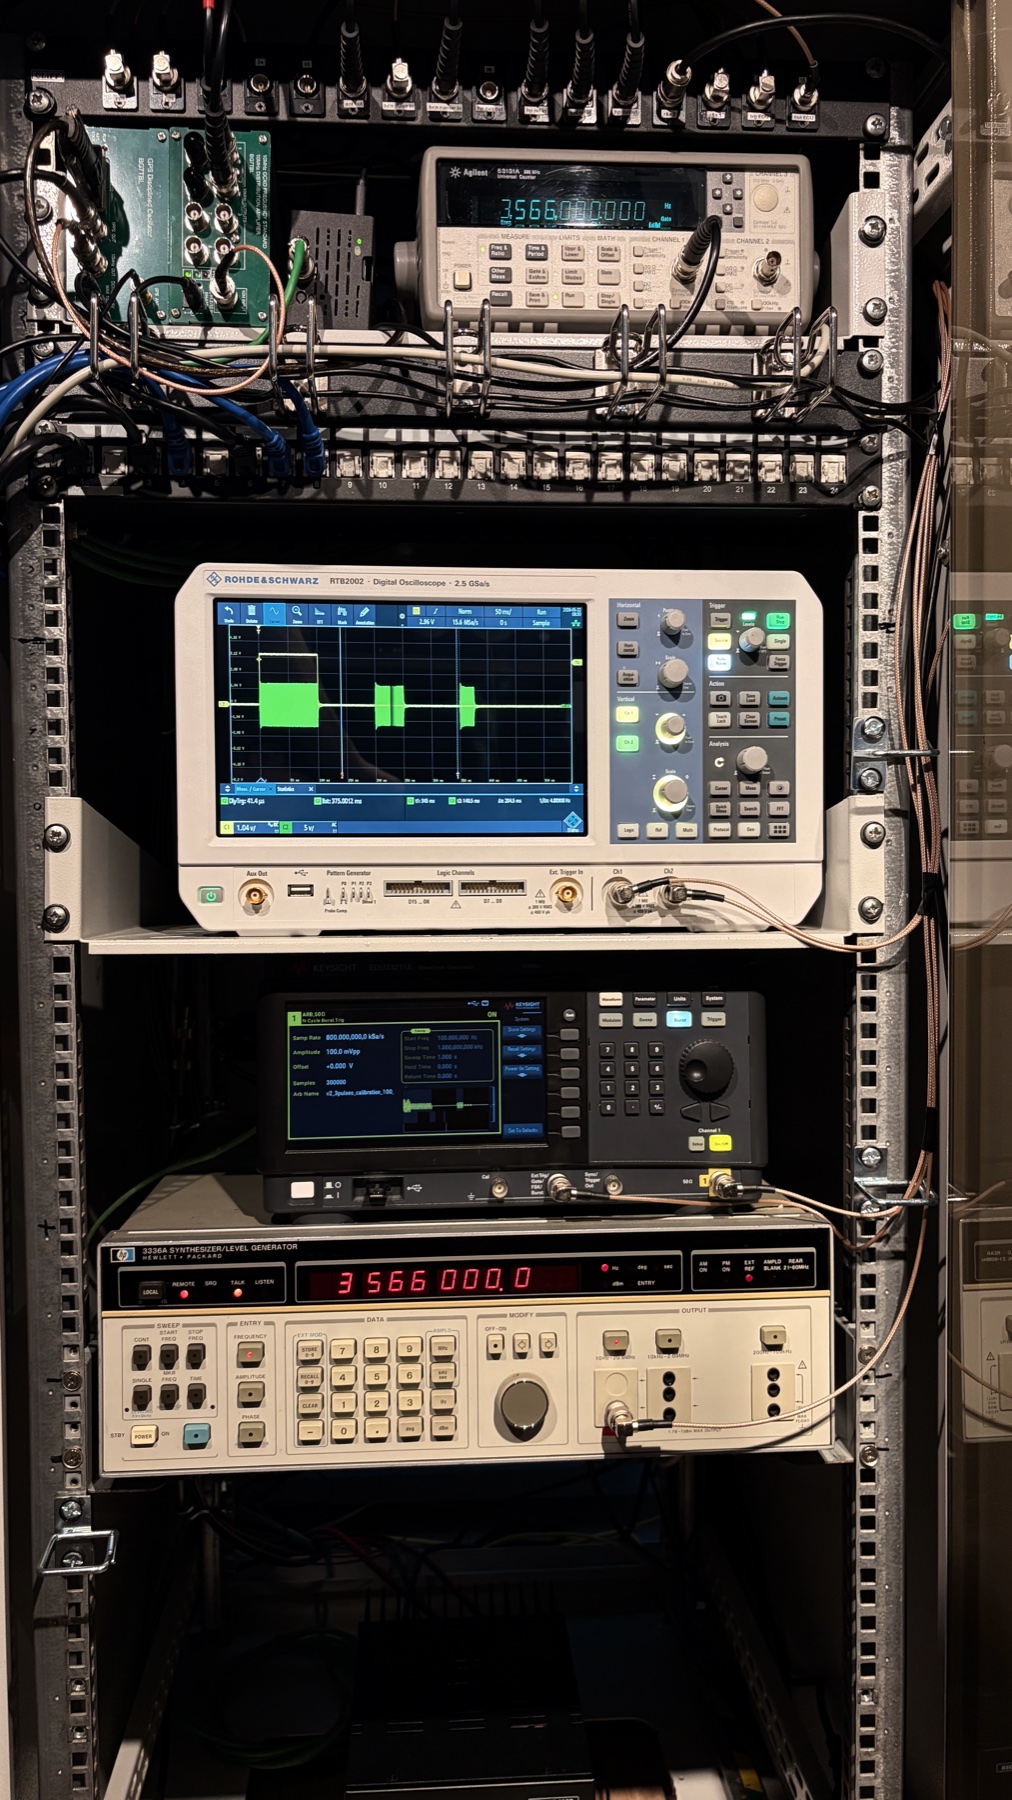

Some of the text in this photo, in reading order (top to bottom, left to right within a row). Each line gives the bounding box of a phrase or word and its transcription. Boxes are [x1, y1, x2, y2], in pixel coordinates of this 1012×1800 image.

[463, 168, 488, 177] Agilent
[224, 576, 319, 584] ROHDE&SCHWARZ
[169, 1245, 249, 1253] SYNTHESIZER/LEVEL
